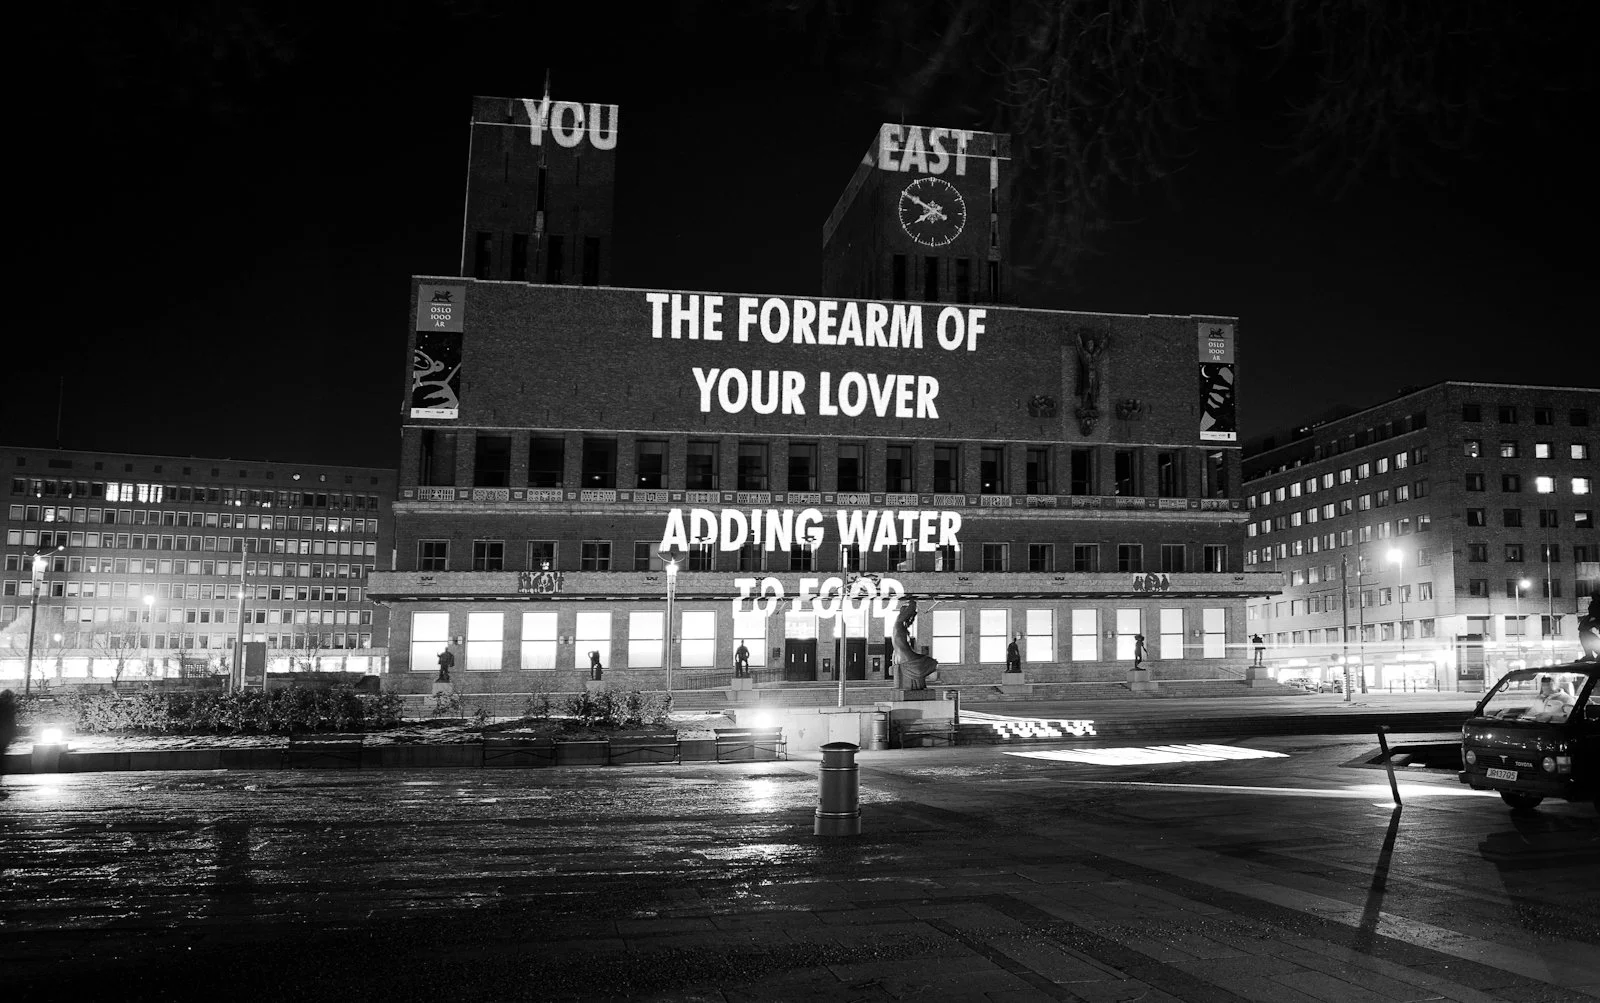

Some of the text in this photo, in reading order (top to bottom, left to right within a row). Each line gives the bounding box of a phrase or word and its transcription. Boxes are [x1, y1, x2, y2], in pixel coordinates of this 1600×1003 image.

[522, 98, 619, 151] YOU
[878, 123, 974, 176] EAST
[645, 292, 987, 352] THE FOREARM OF
[692, 367, 940, 419] YOUR LOVER
[659, 508, 963, 553] ADDING WATER
[732, 577, 906, 621] TO FOOD
